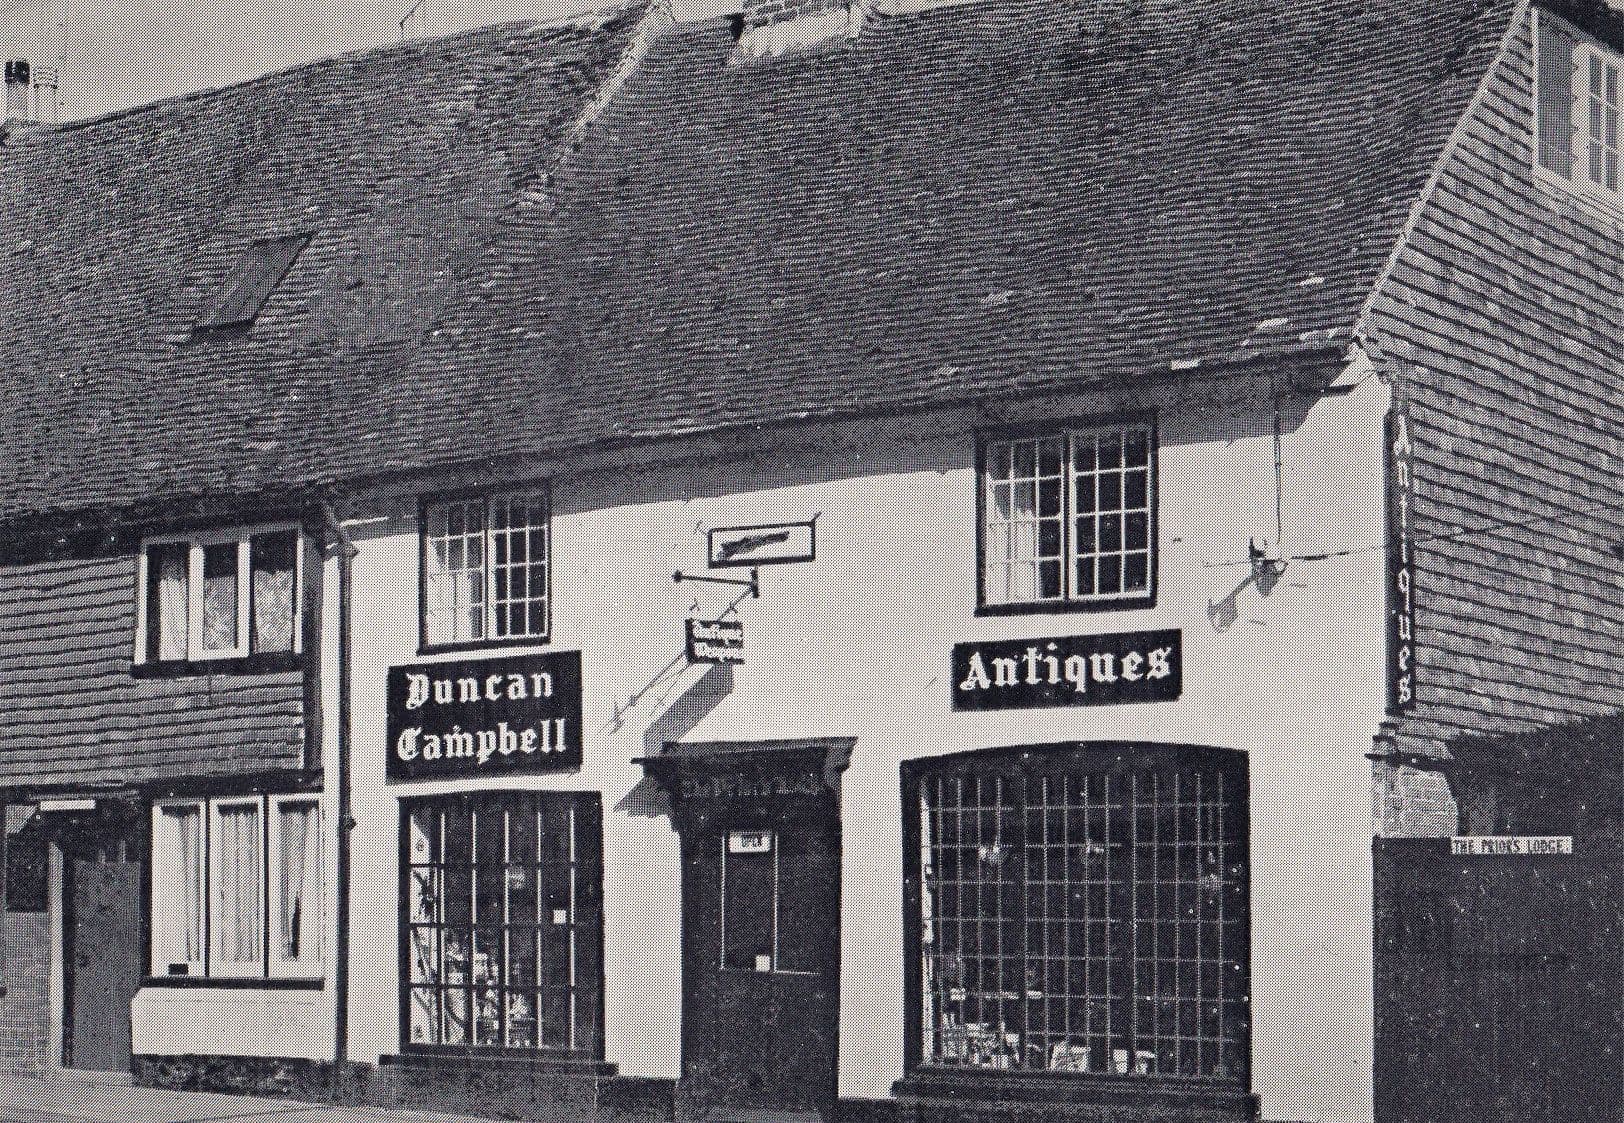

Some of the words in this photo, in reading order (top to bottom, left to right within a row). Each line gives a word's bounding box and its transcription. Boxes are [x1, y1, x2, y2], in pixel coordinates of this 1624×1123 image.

[1393, 413, 1412, 704] Antiques
[405, 671, 554, 710] Duncan
[959, 641, 1172, 693] Antiques
[397, 717, 567, 766] Campbell
[1453, 839, 1475, 854] THE
